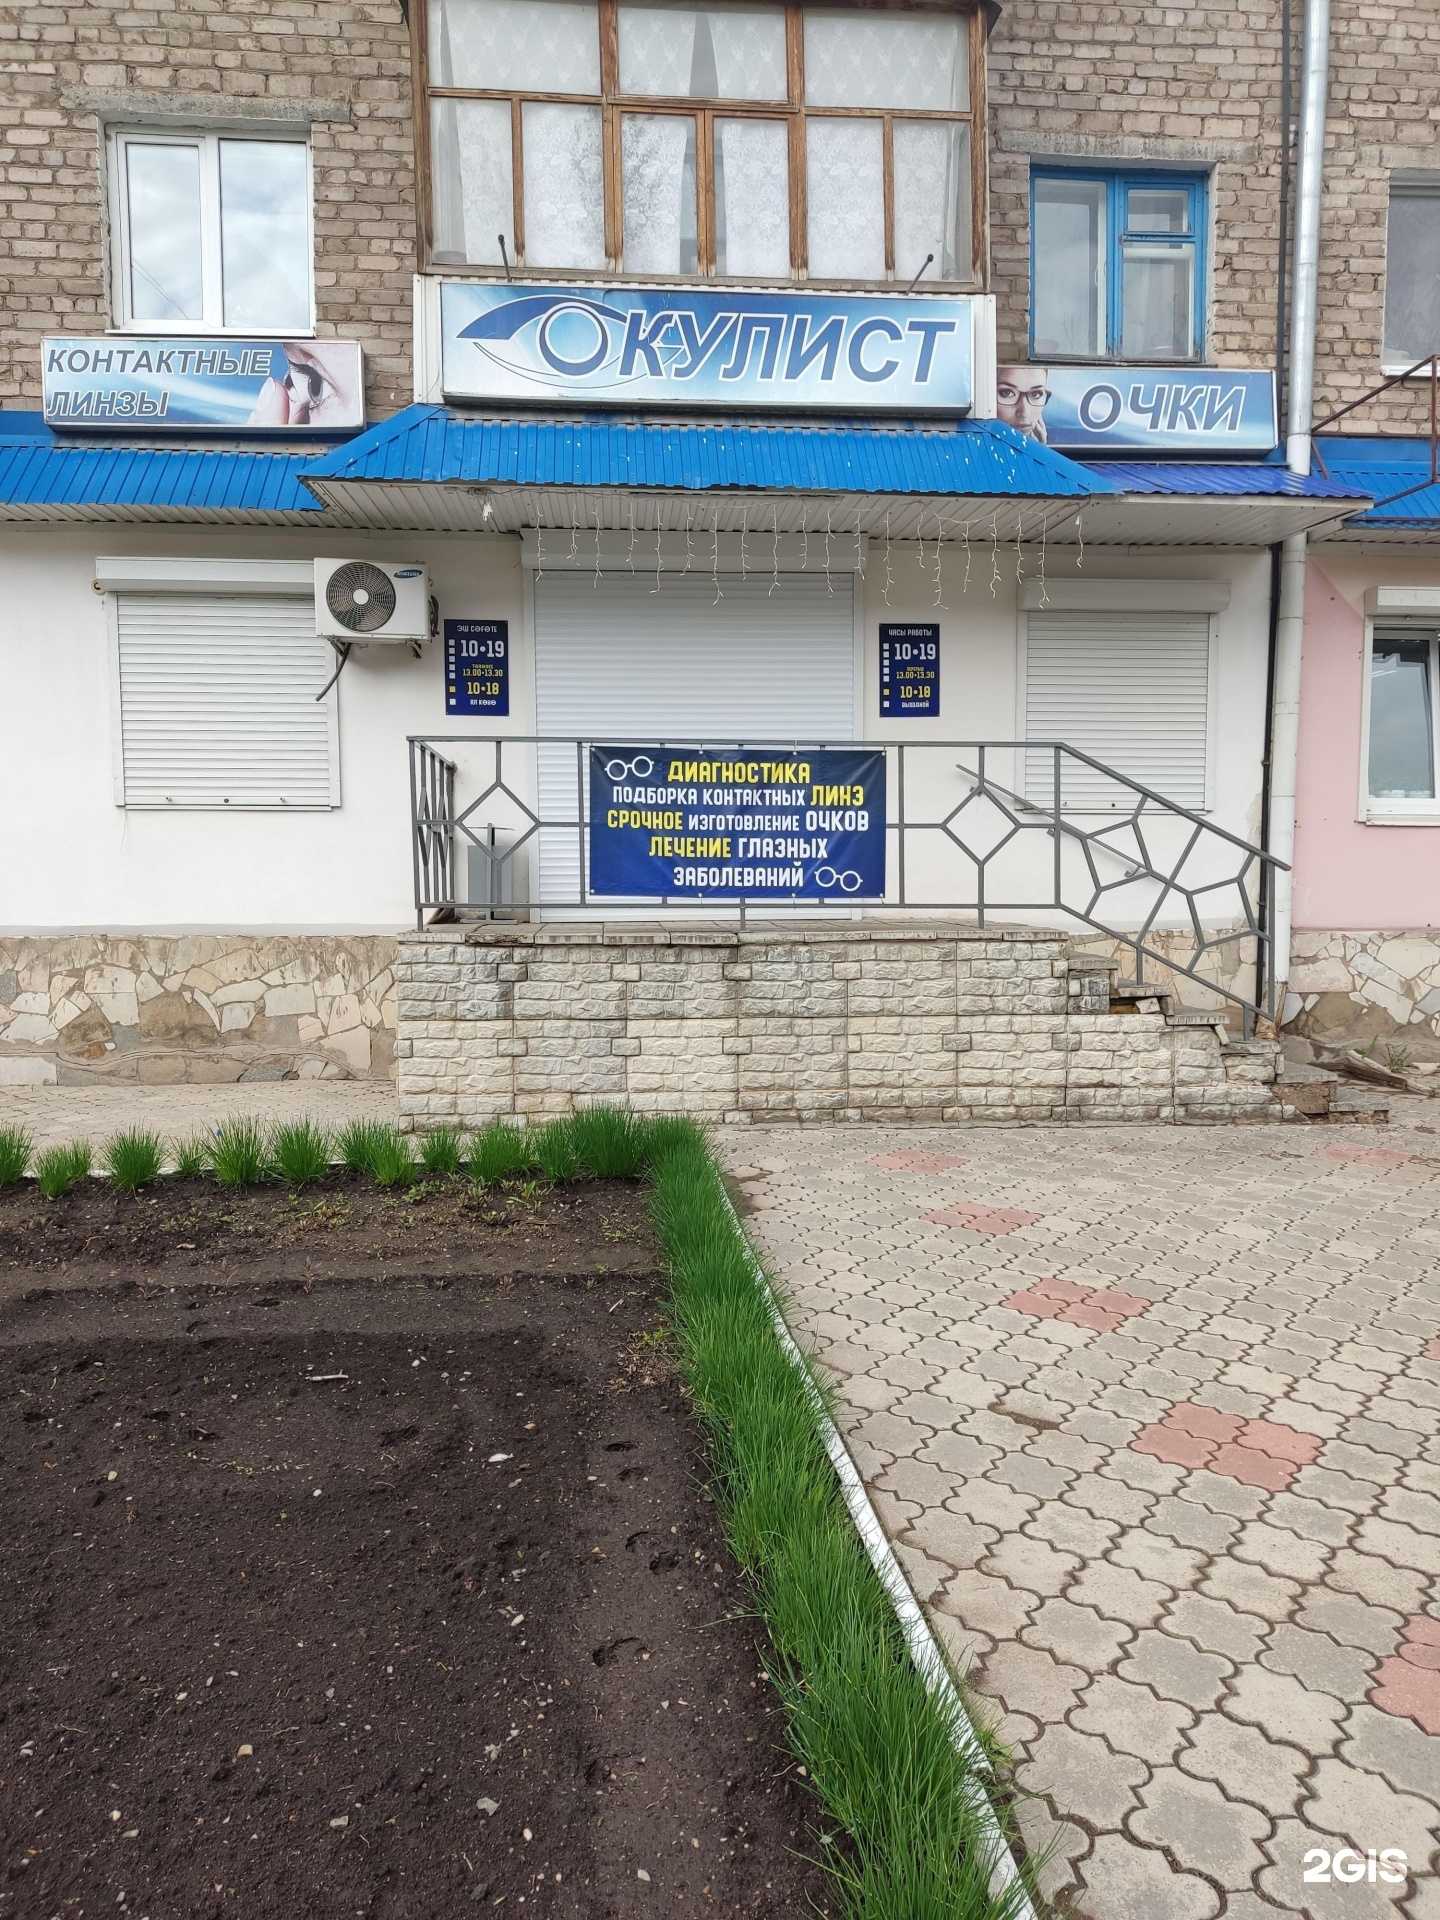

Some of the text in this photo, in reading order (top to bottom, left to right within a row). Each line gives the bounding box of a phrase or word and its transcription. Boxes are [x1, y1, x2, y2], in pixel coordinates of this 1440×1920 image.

[536, 300, 958, 385] ОКУЛИСТ
[47, 348, 272, 376] КОНТАКТНЫЕ
[47, 390, 169, 417] ЛИНЗЫ
[1078, 382, 1246, 433] ОЧКИ
[888, 628, 932, 637] ЧАСЫ РАБОТЫ
[667, 761, 811, 784] ДИАГНОСТИКА
[613, 785, 864, 806] ПОДБОРКА КОНТАКТНЫХ ЛИНЗ
[607, 810, 869, 832] СРОЧНОЕ ИЗГОТОВЛЕНИЕ ОЧКОВ
[649, 837, 828, 858] ЛЕЧЕНИЕ ГЛАЗНЫХ
[673, 861, 804, 887] ЗАБОЛЕВАНИЙ
